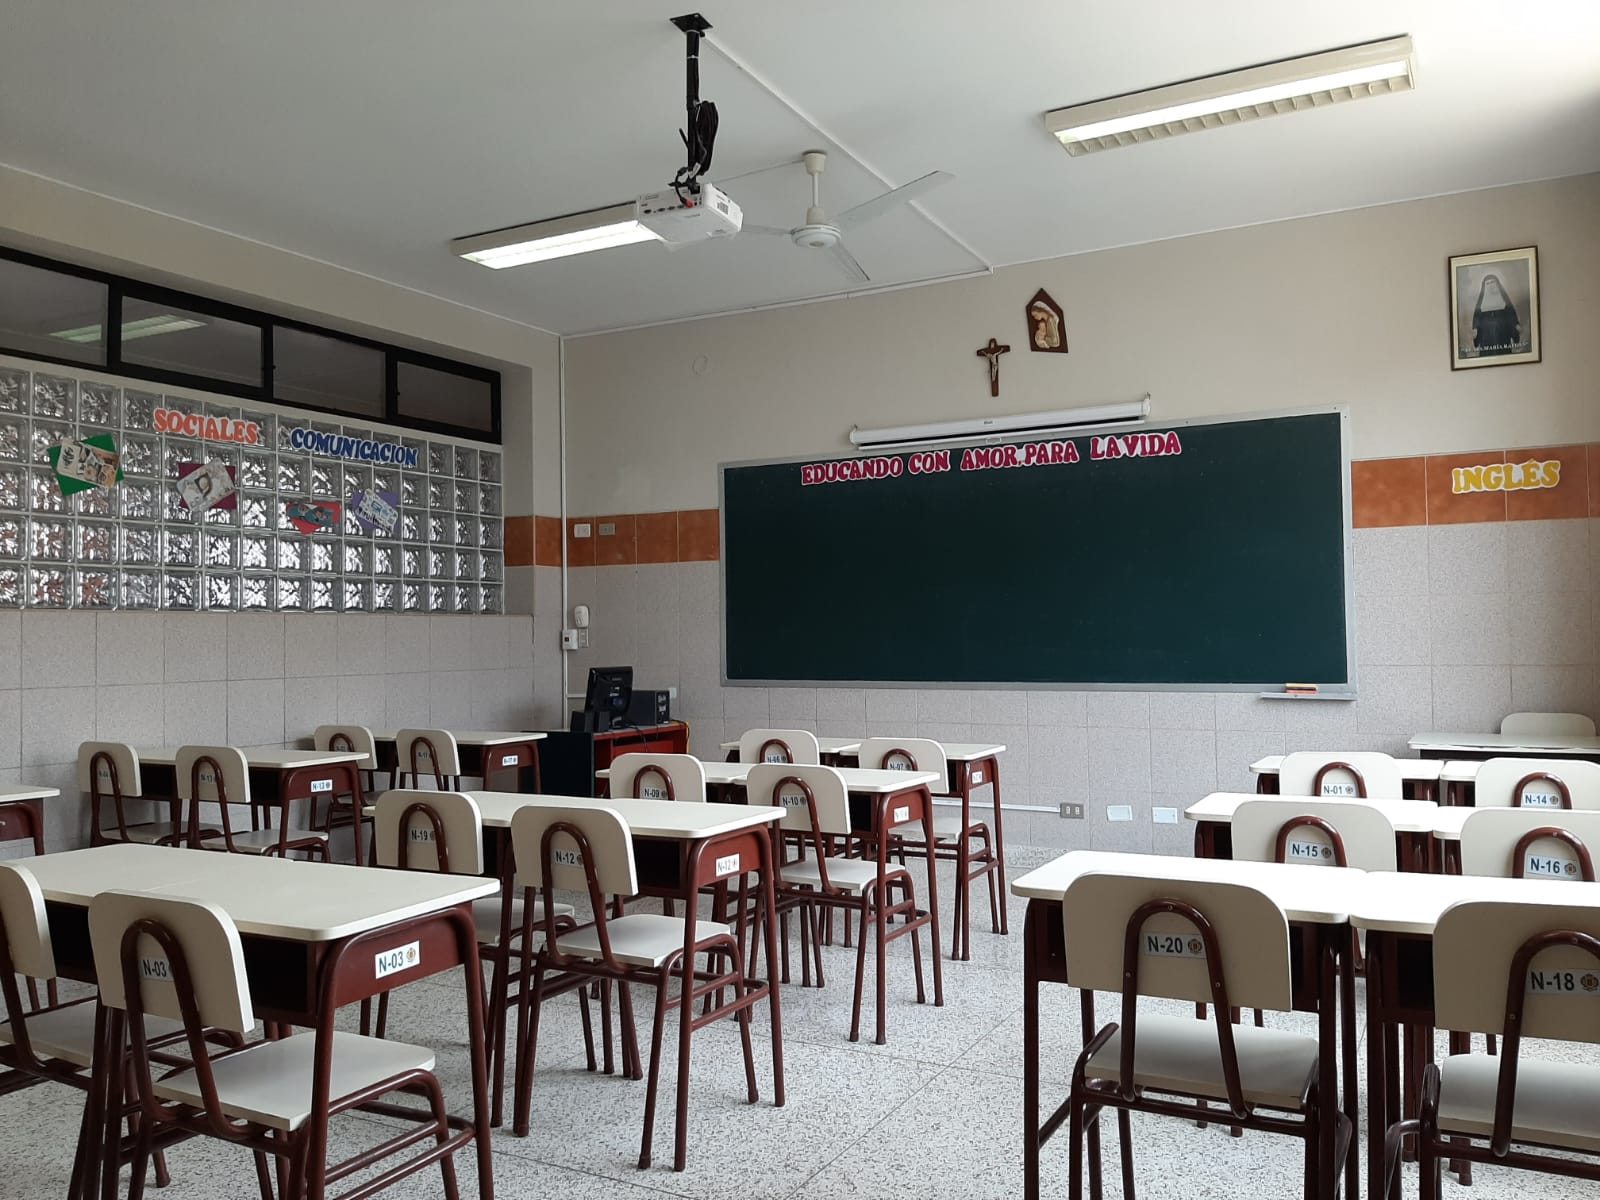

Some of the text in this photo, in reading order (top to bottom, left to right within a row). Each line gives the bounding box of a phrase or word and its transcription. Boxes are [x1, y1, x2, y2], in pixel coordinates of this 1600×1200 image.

[153, 409, 259, 444] SOCIALES
[292, 428, 418, 467] COMUNICACION
[802, 457, 903, 485] EDUCANDO
[908, 450, 950, 474] CON
[1024, 441, 1079, 465] PARA
[1122, 432, 1181, 457] VIDA
[1452, 458, 1560, 493] INGLÉS
[1323, 785, 1342, 795] N-01
[782, 795, 799, 806] N-10
[1525, 794, 1547, 805] N-14
[411, 829, 428, 841] N-19
[555, 851, 575, 864] N-12
[1292, 843, 1318, 857] N-15
[717, 859, 731, 873] N-12
[1530, 857, 1561, 874] N-16
[1147, 935, 1183, 954] N-20
[143, 959, 167, 978] N-03
[378, 951, 404, 974] N-03
[1530, 971, 1575, 992] N-18
